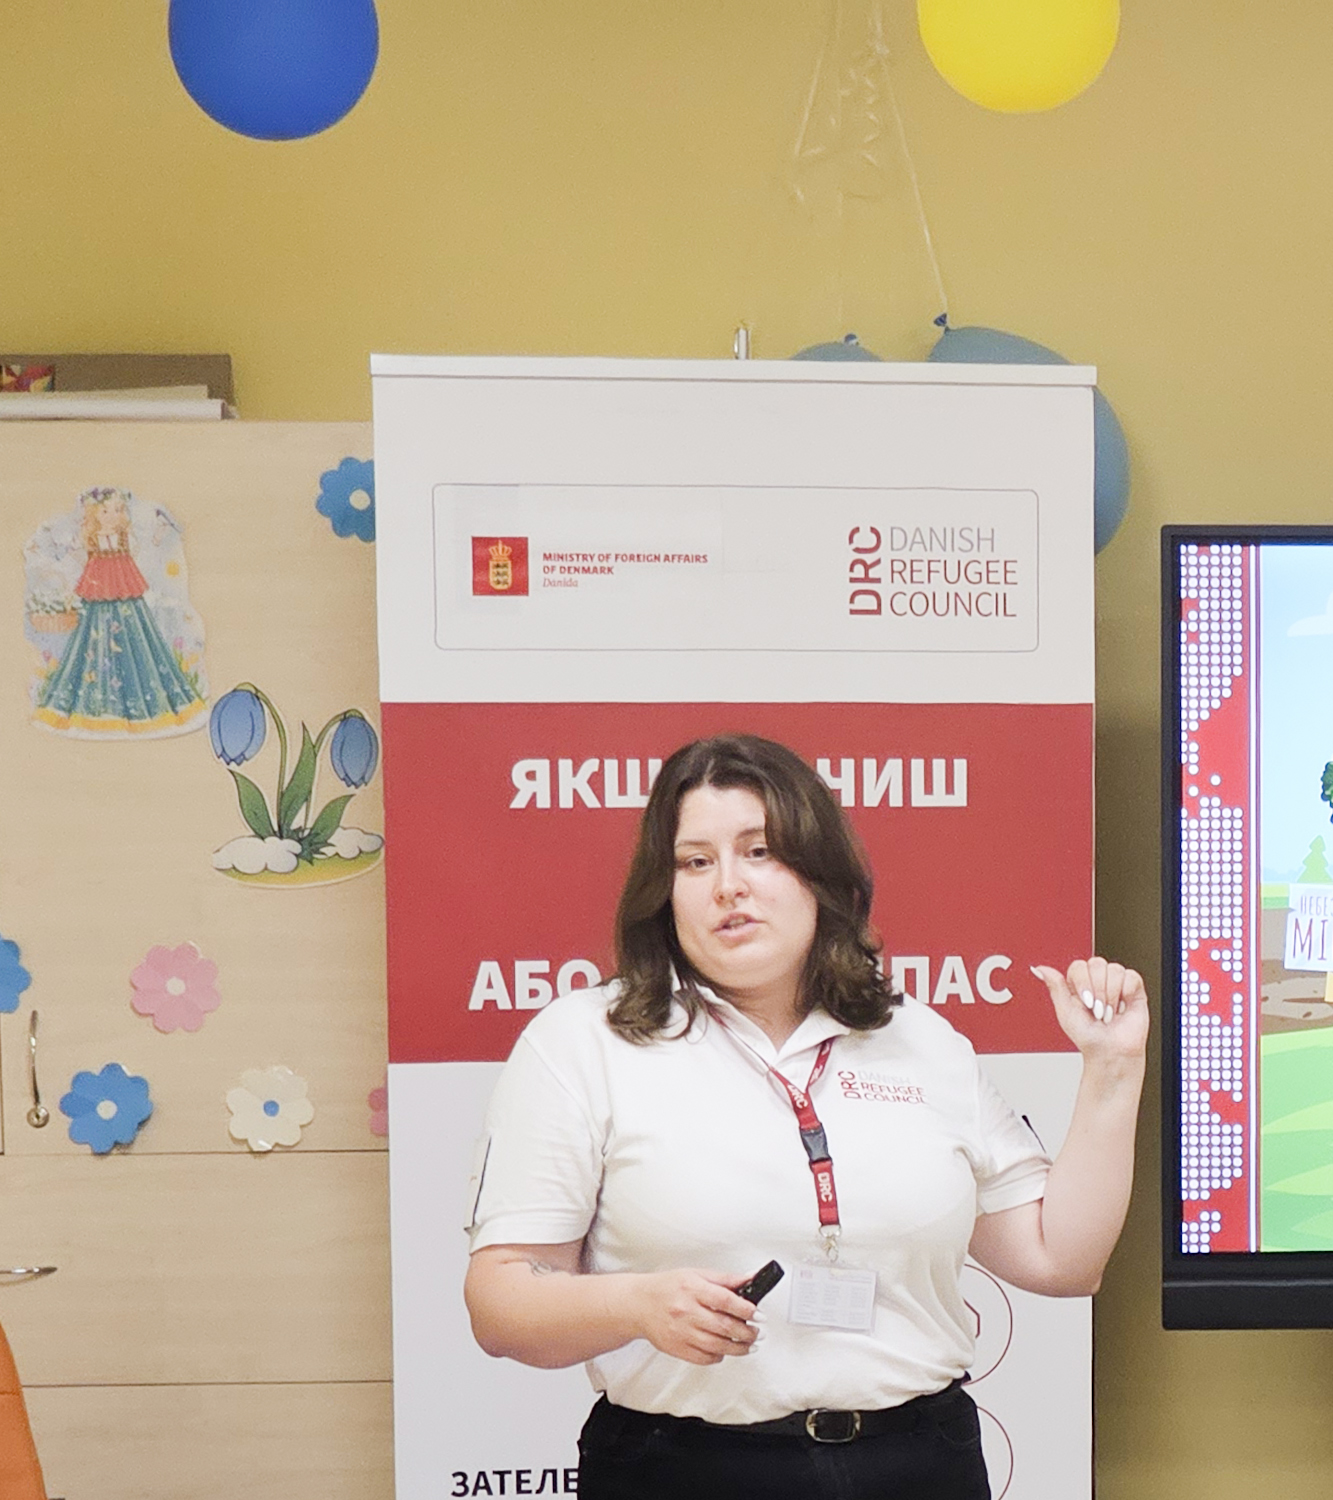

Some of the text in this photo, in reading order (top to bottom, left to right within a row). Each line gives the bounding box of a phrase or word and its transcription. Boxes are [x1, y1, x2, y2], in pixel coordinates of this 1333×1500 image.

[890, 526, 996, 554] DANISH
[543, 552, 708, 564] MINISTRY OF FOREIGN AFFAIRS
[543, 565, 614, 575] OF DENMARK
[848, 526, 882, 616] DRC
[543, 577, 578, 588] Danida
[890, 559, 1018, 586] REFUGEE
[889, 591, 1017, 618] COUNCIL
[817, 758, 967, 807] ЧИШ
[878, 955, 1013, 1005] ПАС
[837, 1071, 862, 1100] DRC
[861, 1082, 925, 1096] REFUGEE
[864, 1092, 930, 1106] COUNCIL
[817, 1171, 833, 1203] DRC
[451, 1468, 579, 1497] ЗАТЕЛЕ
